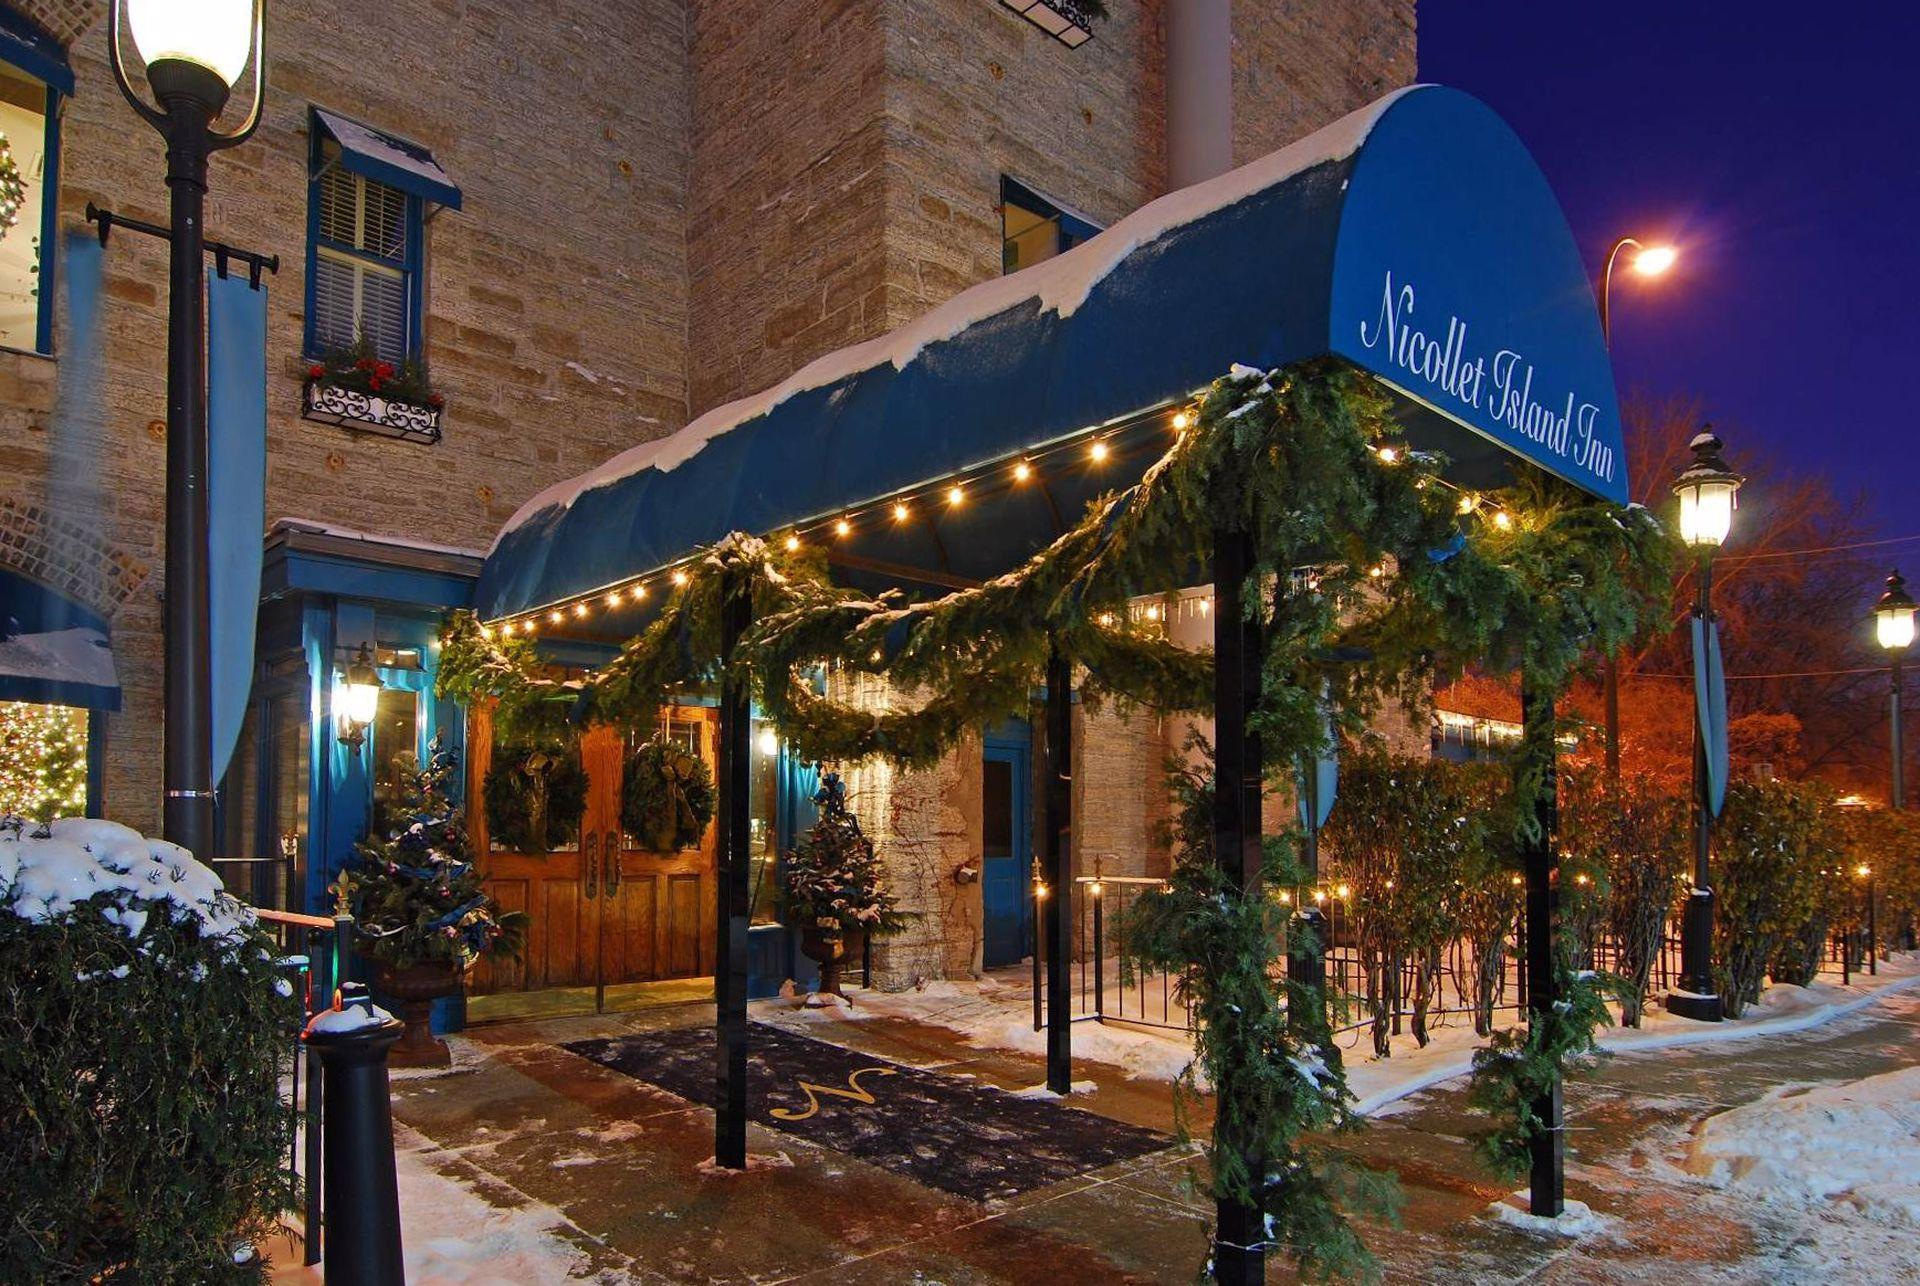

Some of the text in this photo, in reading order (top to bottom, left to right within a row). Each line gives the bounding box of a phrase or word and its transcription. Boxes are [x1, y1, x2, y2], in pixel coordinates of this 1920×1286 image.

[1360, 270, 1616, 484] Nicollet Island Inn
[768, 1067, 898, 1122] N
